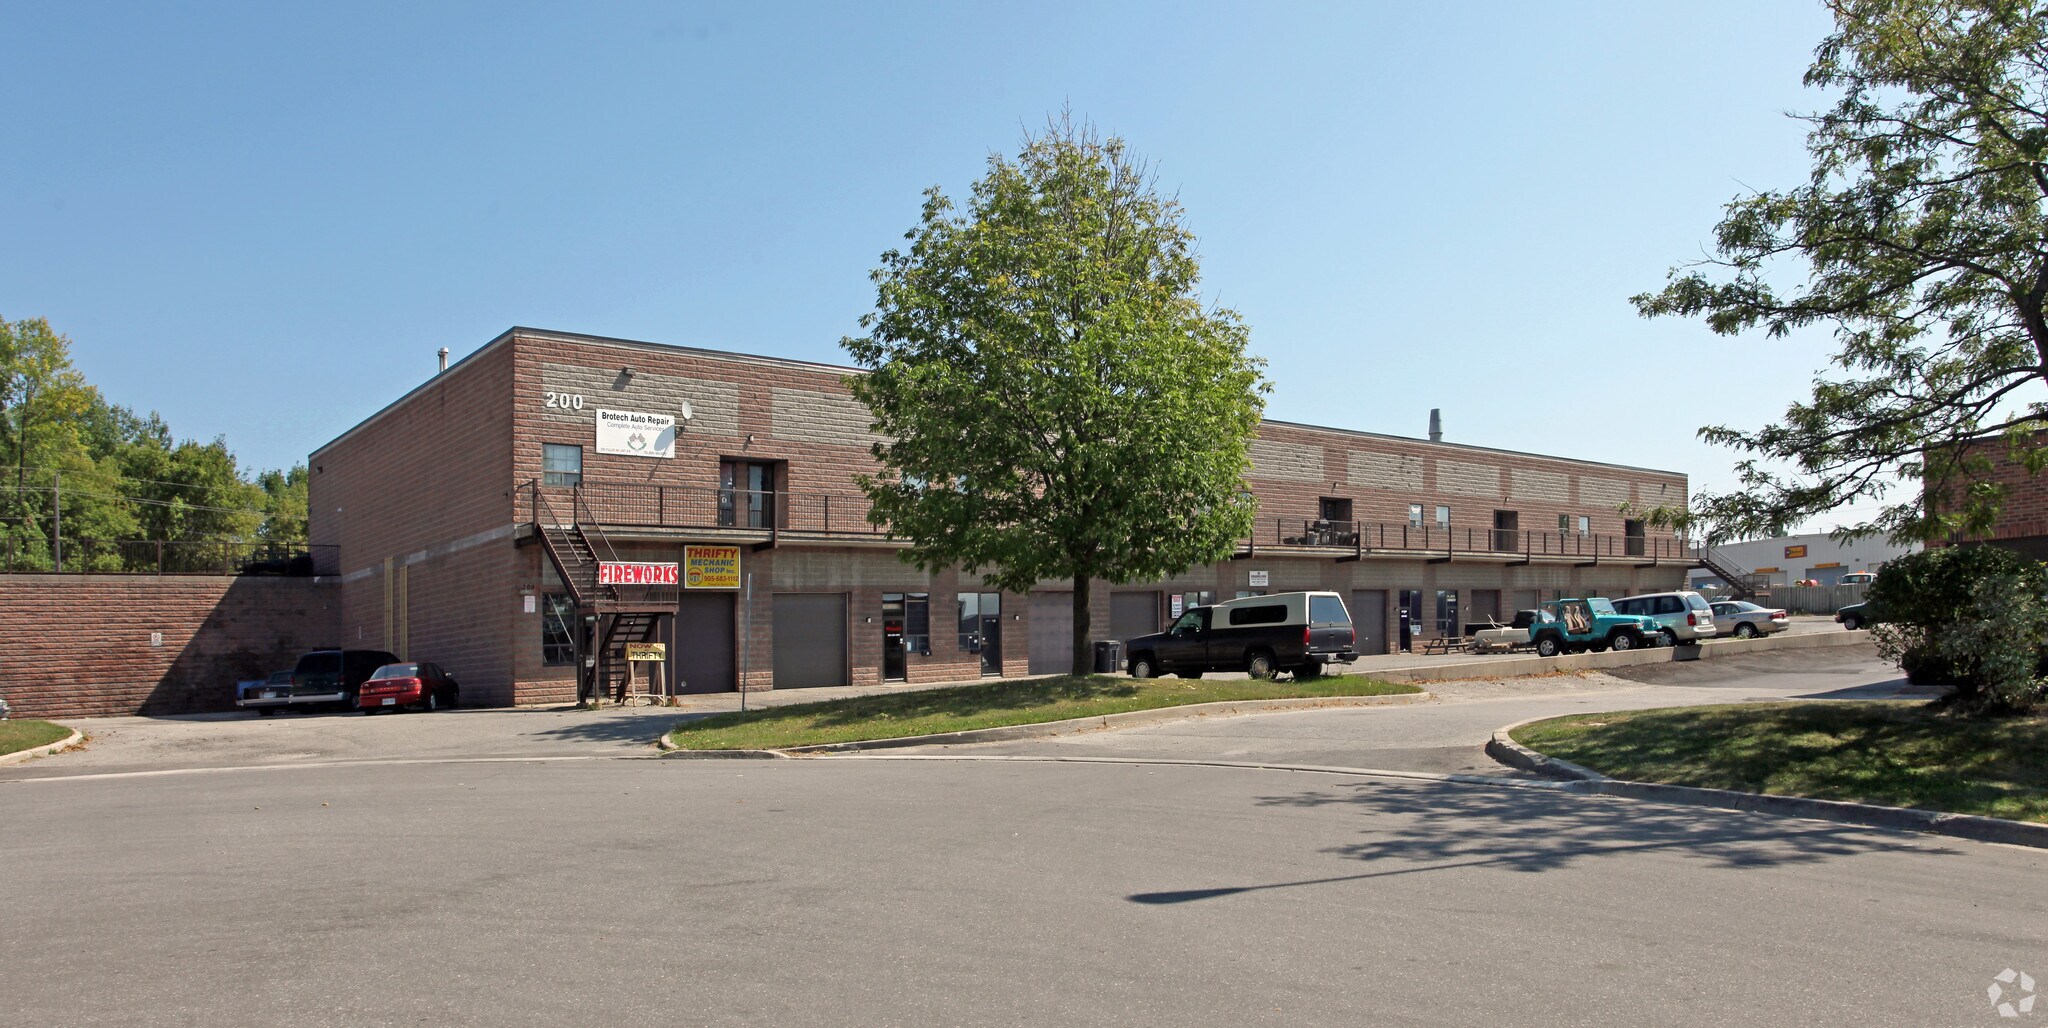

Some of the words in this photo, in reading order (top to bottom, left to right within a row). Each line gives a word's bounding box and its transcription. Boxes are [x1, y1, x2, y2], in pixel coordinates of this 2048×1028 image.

[546, 391, 583, 410] 200
[601, 411, 629, 422] Brotech
[630, 414, 646, 424] Auto
[647, 416, 670, 426] Repair
[606, 421, 630, 430] Complete
[687, 548, 737, 558] THRIFTY
[600, 564, 678, 584] FIREWORKS
[631, 651, 664, 660] THRIFTY
